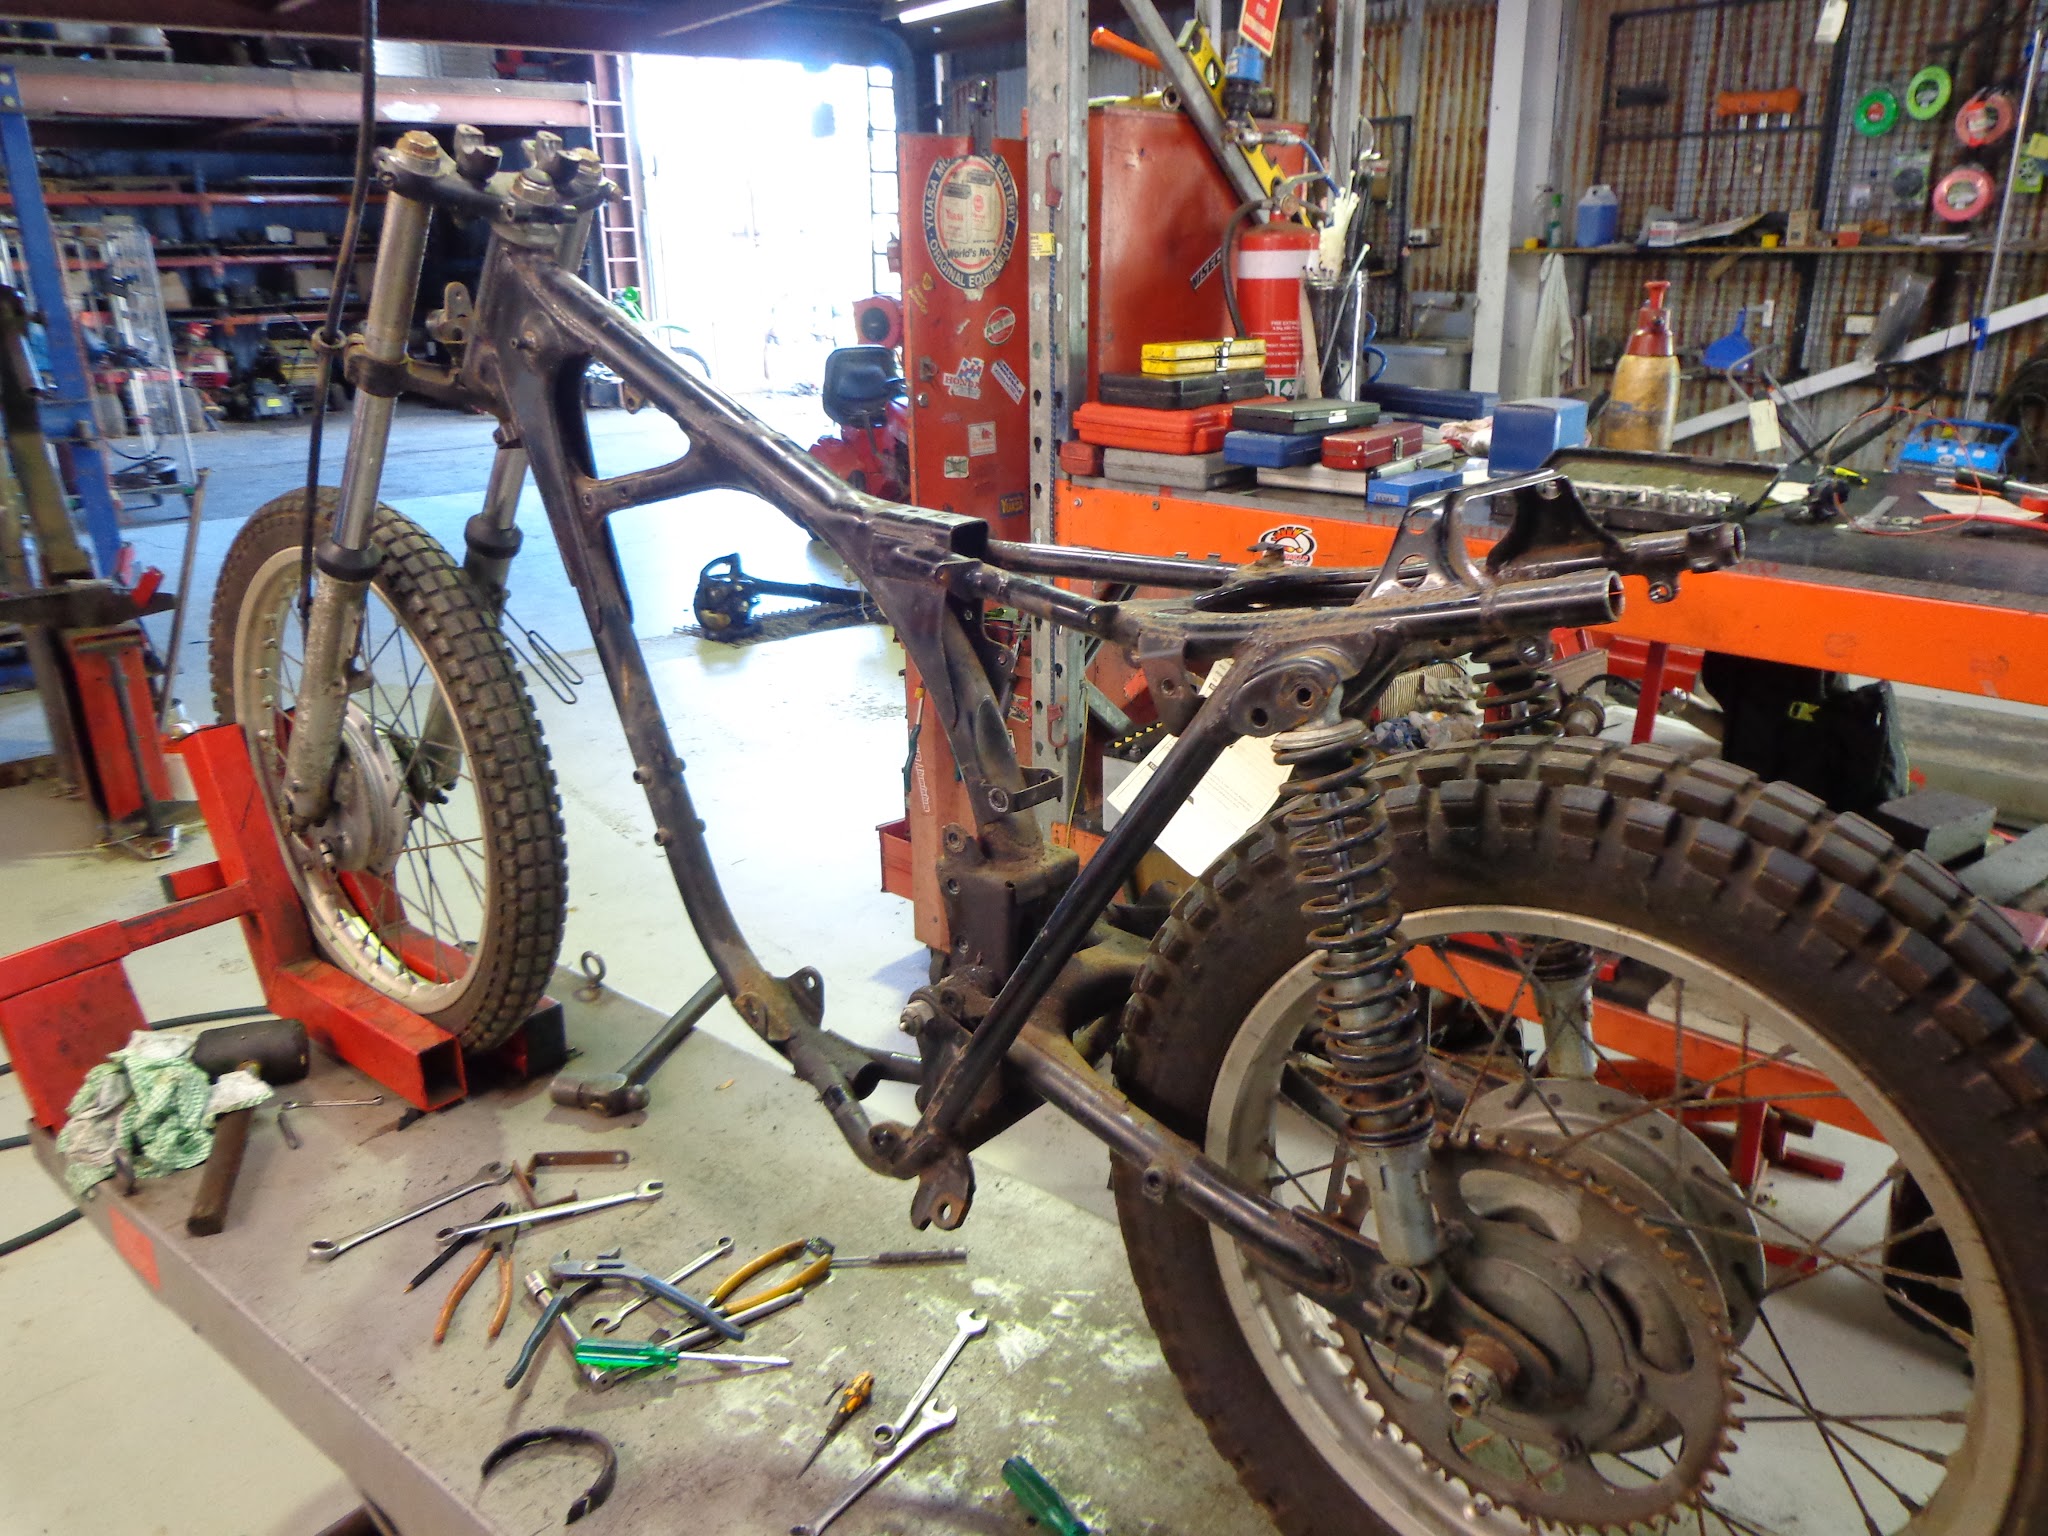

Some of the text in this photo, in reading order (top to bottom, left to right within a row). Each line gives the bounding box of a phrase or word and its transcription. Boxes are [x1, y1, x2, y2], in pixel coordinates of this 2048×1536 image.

[925, 182, 937, 230] YUASA
[997, 164, 1017, 223] BATTERY
[930, 235, 1012, 287] ORIGINAL EQUIPMENT
[945, 375, 980, 388] HONDA
